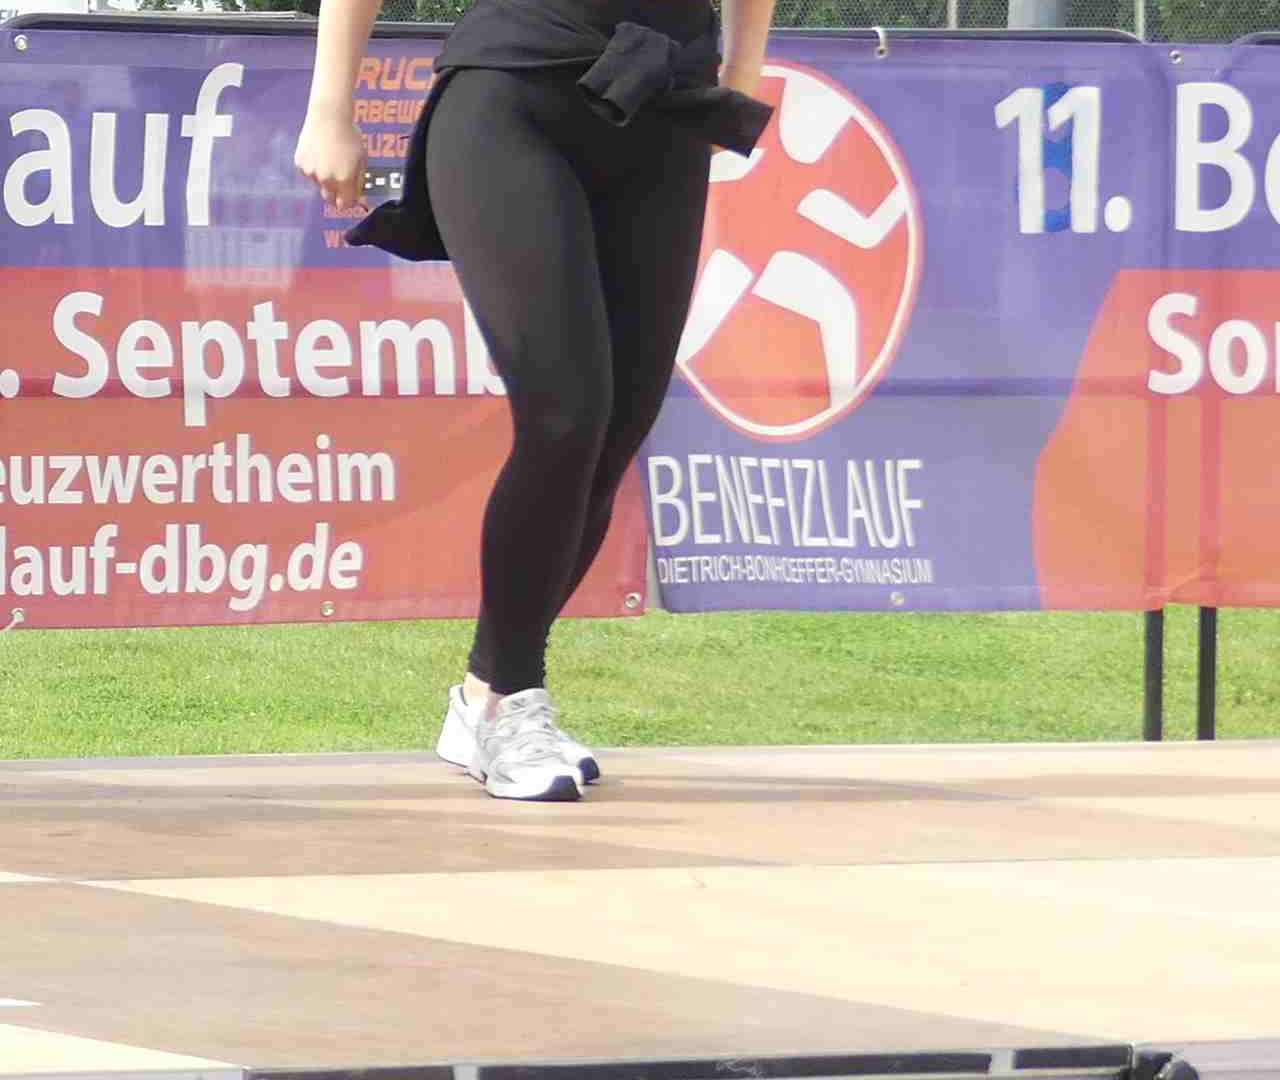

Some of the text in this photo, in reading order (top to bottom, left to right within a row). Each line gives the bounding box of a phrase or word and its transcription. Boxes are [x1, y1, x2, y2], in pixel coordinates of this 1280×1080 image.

[354, 56, 434, 90] RUC
[994, 81, 1280, 234] 11. B
[1147, 292, 1280, 395] So
[647, 454, 924, 549] BENEFIZLAUF
